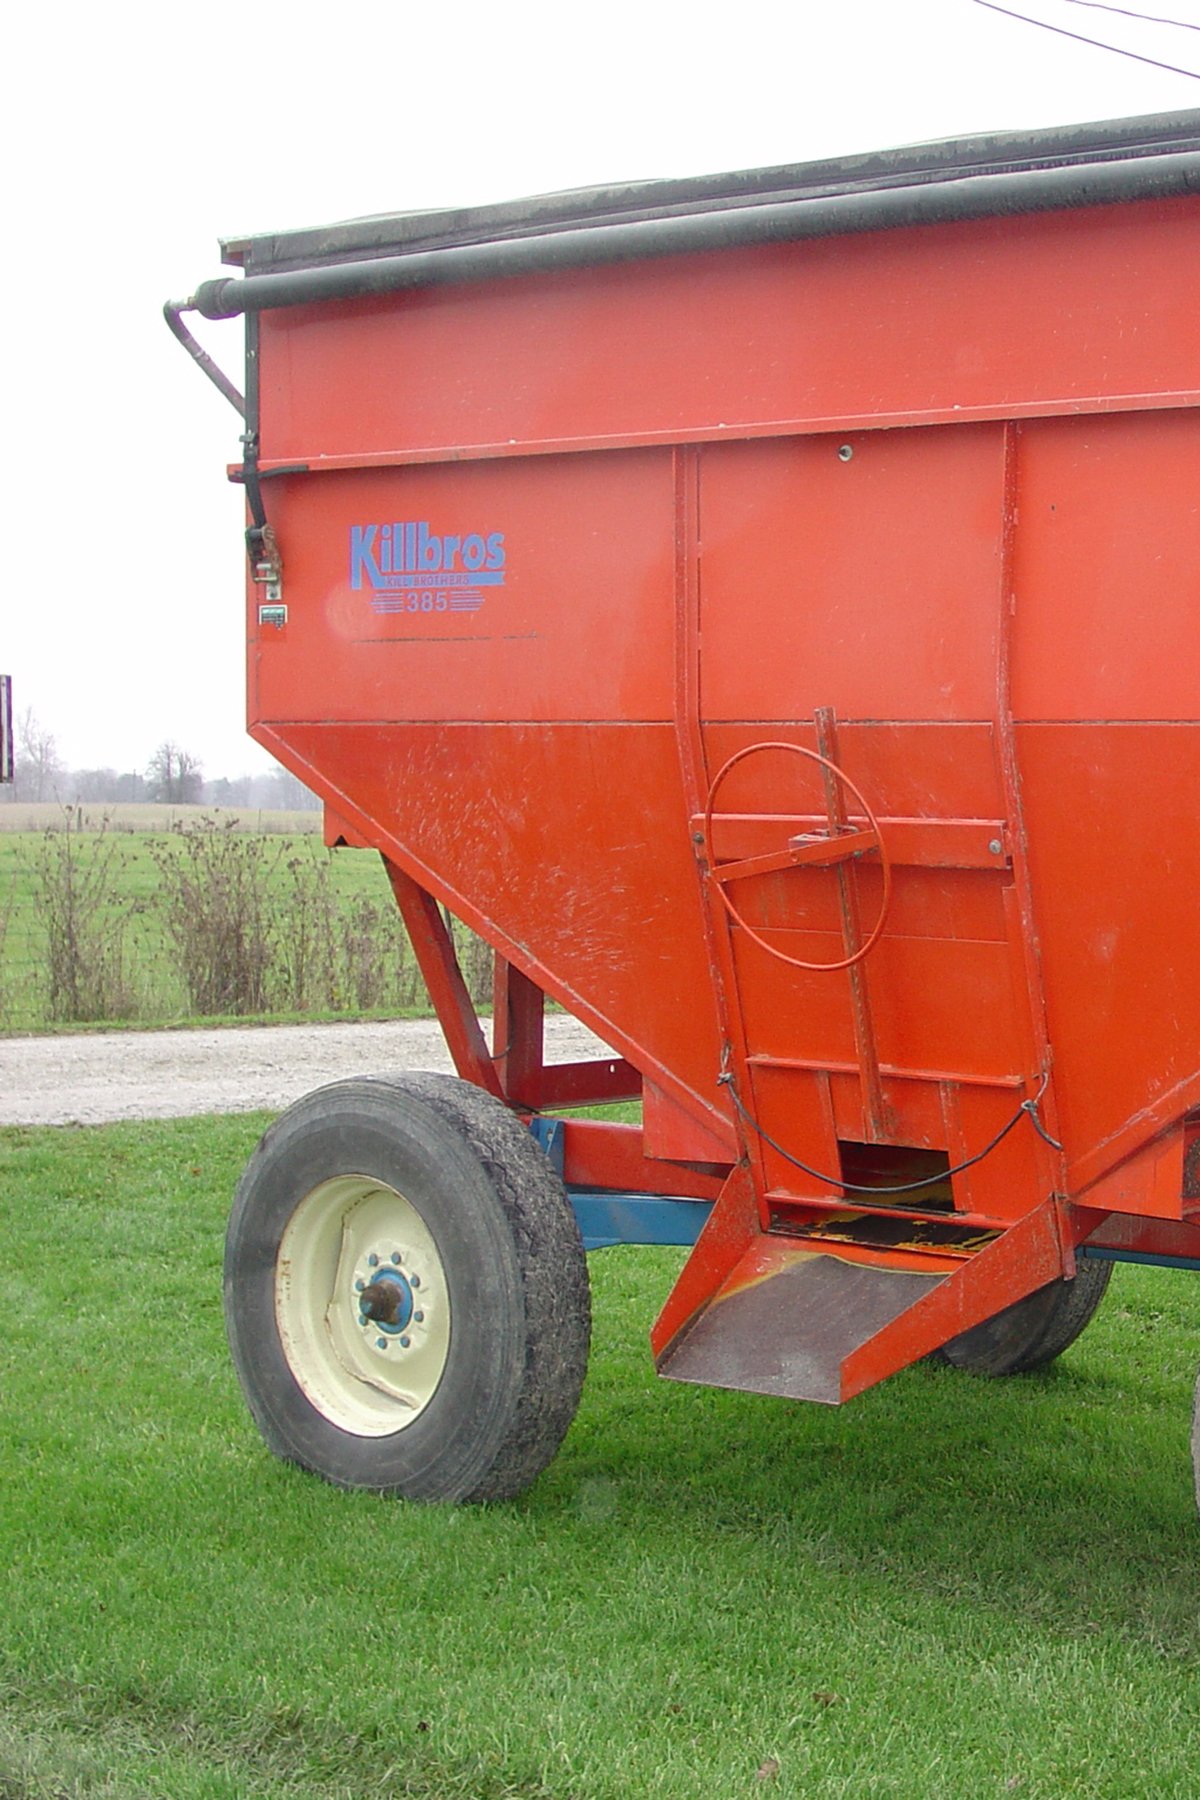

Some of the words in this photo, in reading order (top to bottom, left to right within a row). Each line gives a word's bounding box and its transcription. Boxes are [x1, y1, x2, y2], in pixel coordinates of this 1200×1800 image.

[350, 521, 506, 591] Killbros
[386, 575, 408, 587] KILL
[413, 574, 470, 587] BROTHERS
[406, 591, 448, 612] 385
